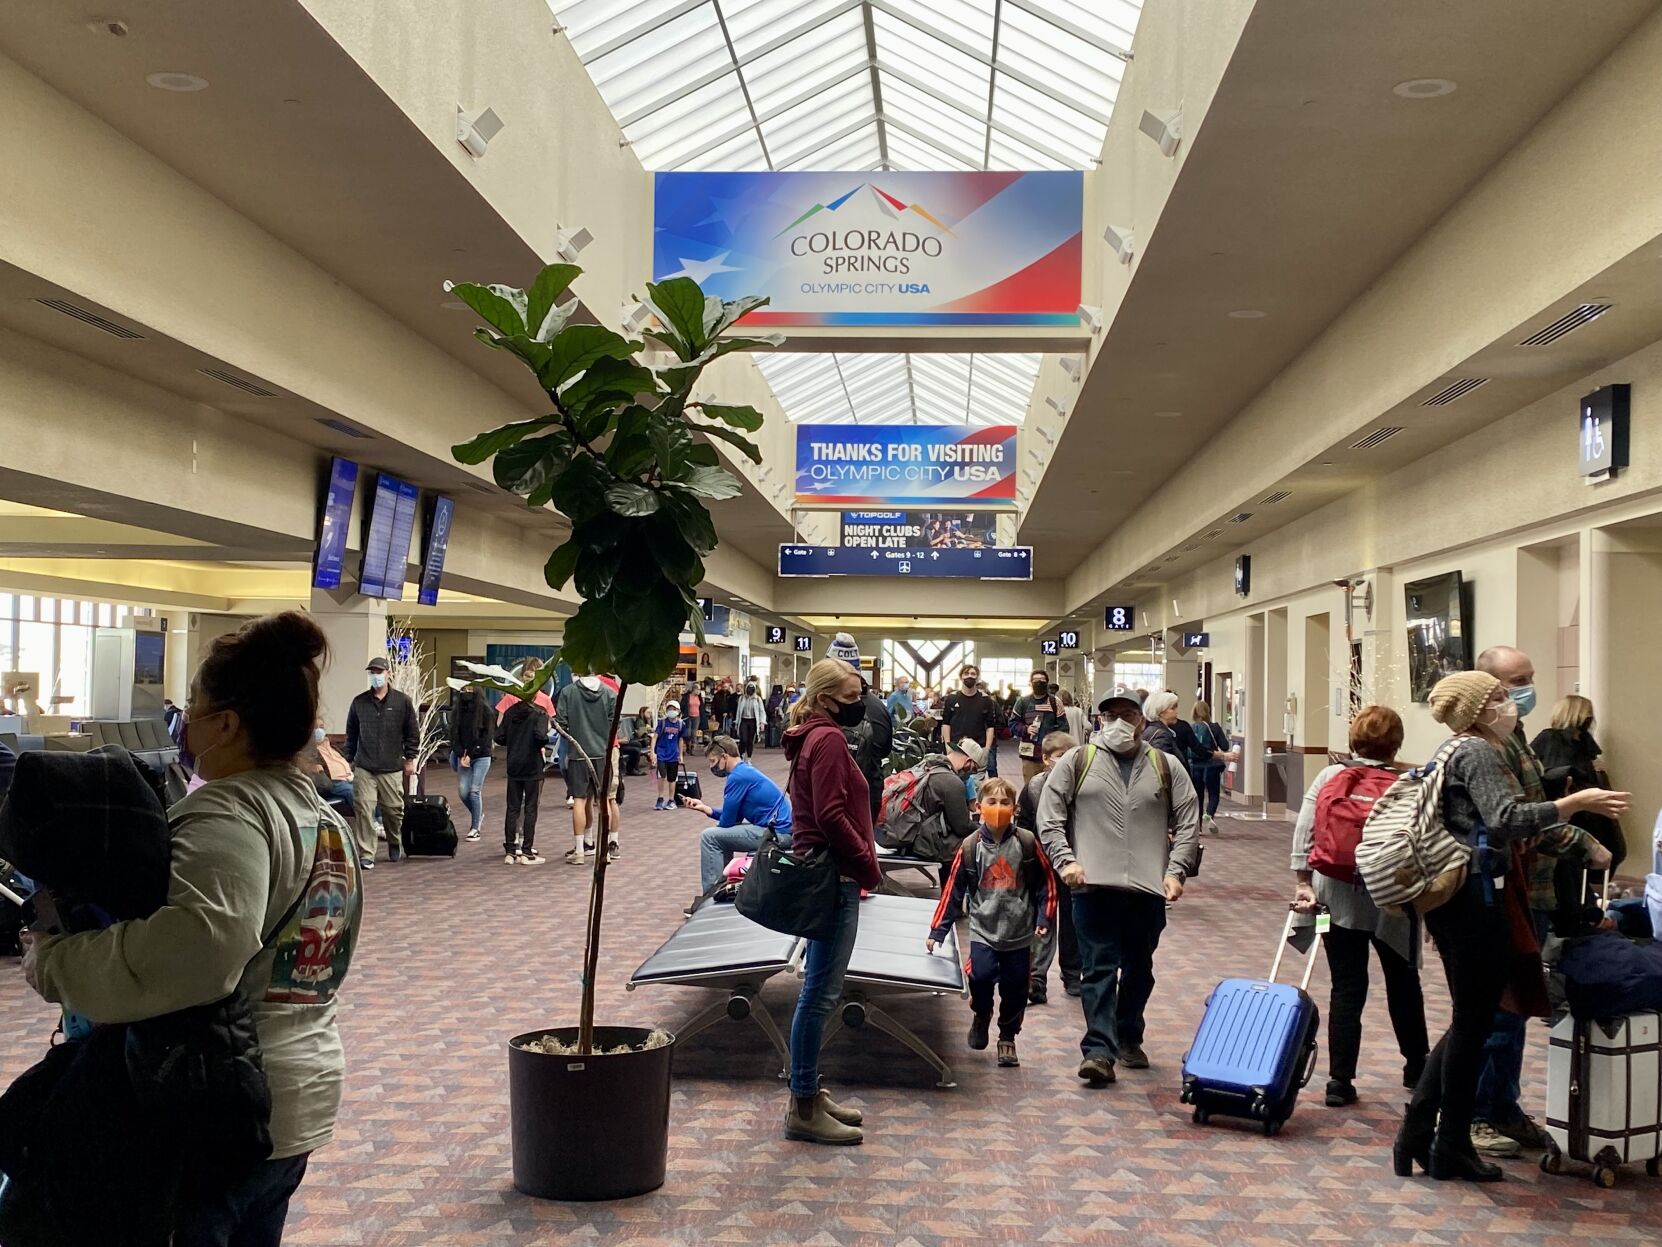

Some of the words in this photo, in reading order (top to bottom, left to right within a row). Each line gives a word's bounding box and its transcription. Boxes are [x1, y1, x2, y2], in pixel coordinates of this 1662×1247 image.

[791, 230, 943, 258] COLORADO
[823, 255, 910, 275] SPRINGS
[800, 283, 862, 294] OLYMPIC
[864, 283, 896, 294] CITY
[898, 283, 931, 294] USA
[810, 442, 882, 462] THANKS
[887, 443, 922, 462] FOR
[927, 443, 1004, 463] VISITING
[810, 464, 900, 481] OLYMPIC
[904, 465, 950, 481] CITY
[953, 465, 1002, 481] USA
[844, 525, 881, 536] NIGHT
[882, 525, 921, 537] CLUBS
[844, 536, 877, 548] OPEN
[878, 536, 907, 548] LATE
[885, 551, 905, 559] Gates
[905, 551, 911, 559] 9
[916, 551, 925, 559] 12
[1113, 607, 1125, 625] 8
[772, 627, 781, 640] 9
[1060, 632, 1077, 645] 10
[797, 637, 809, 648] 11
[1042, 641, 1056, 652] 12
[1113, 687, 1125, 698] P
